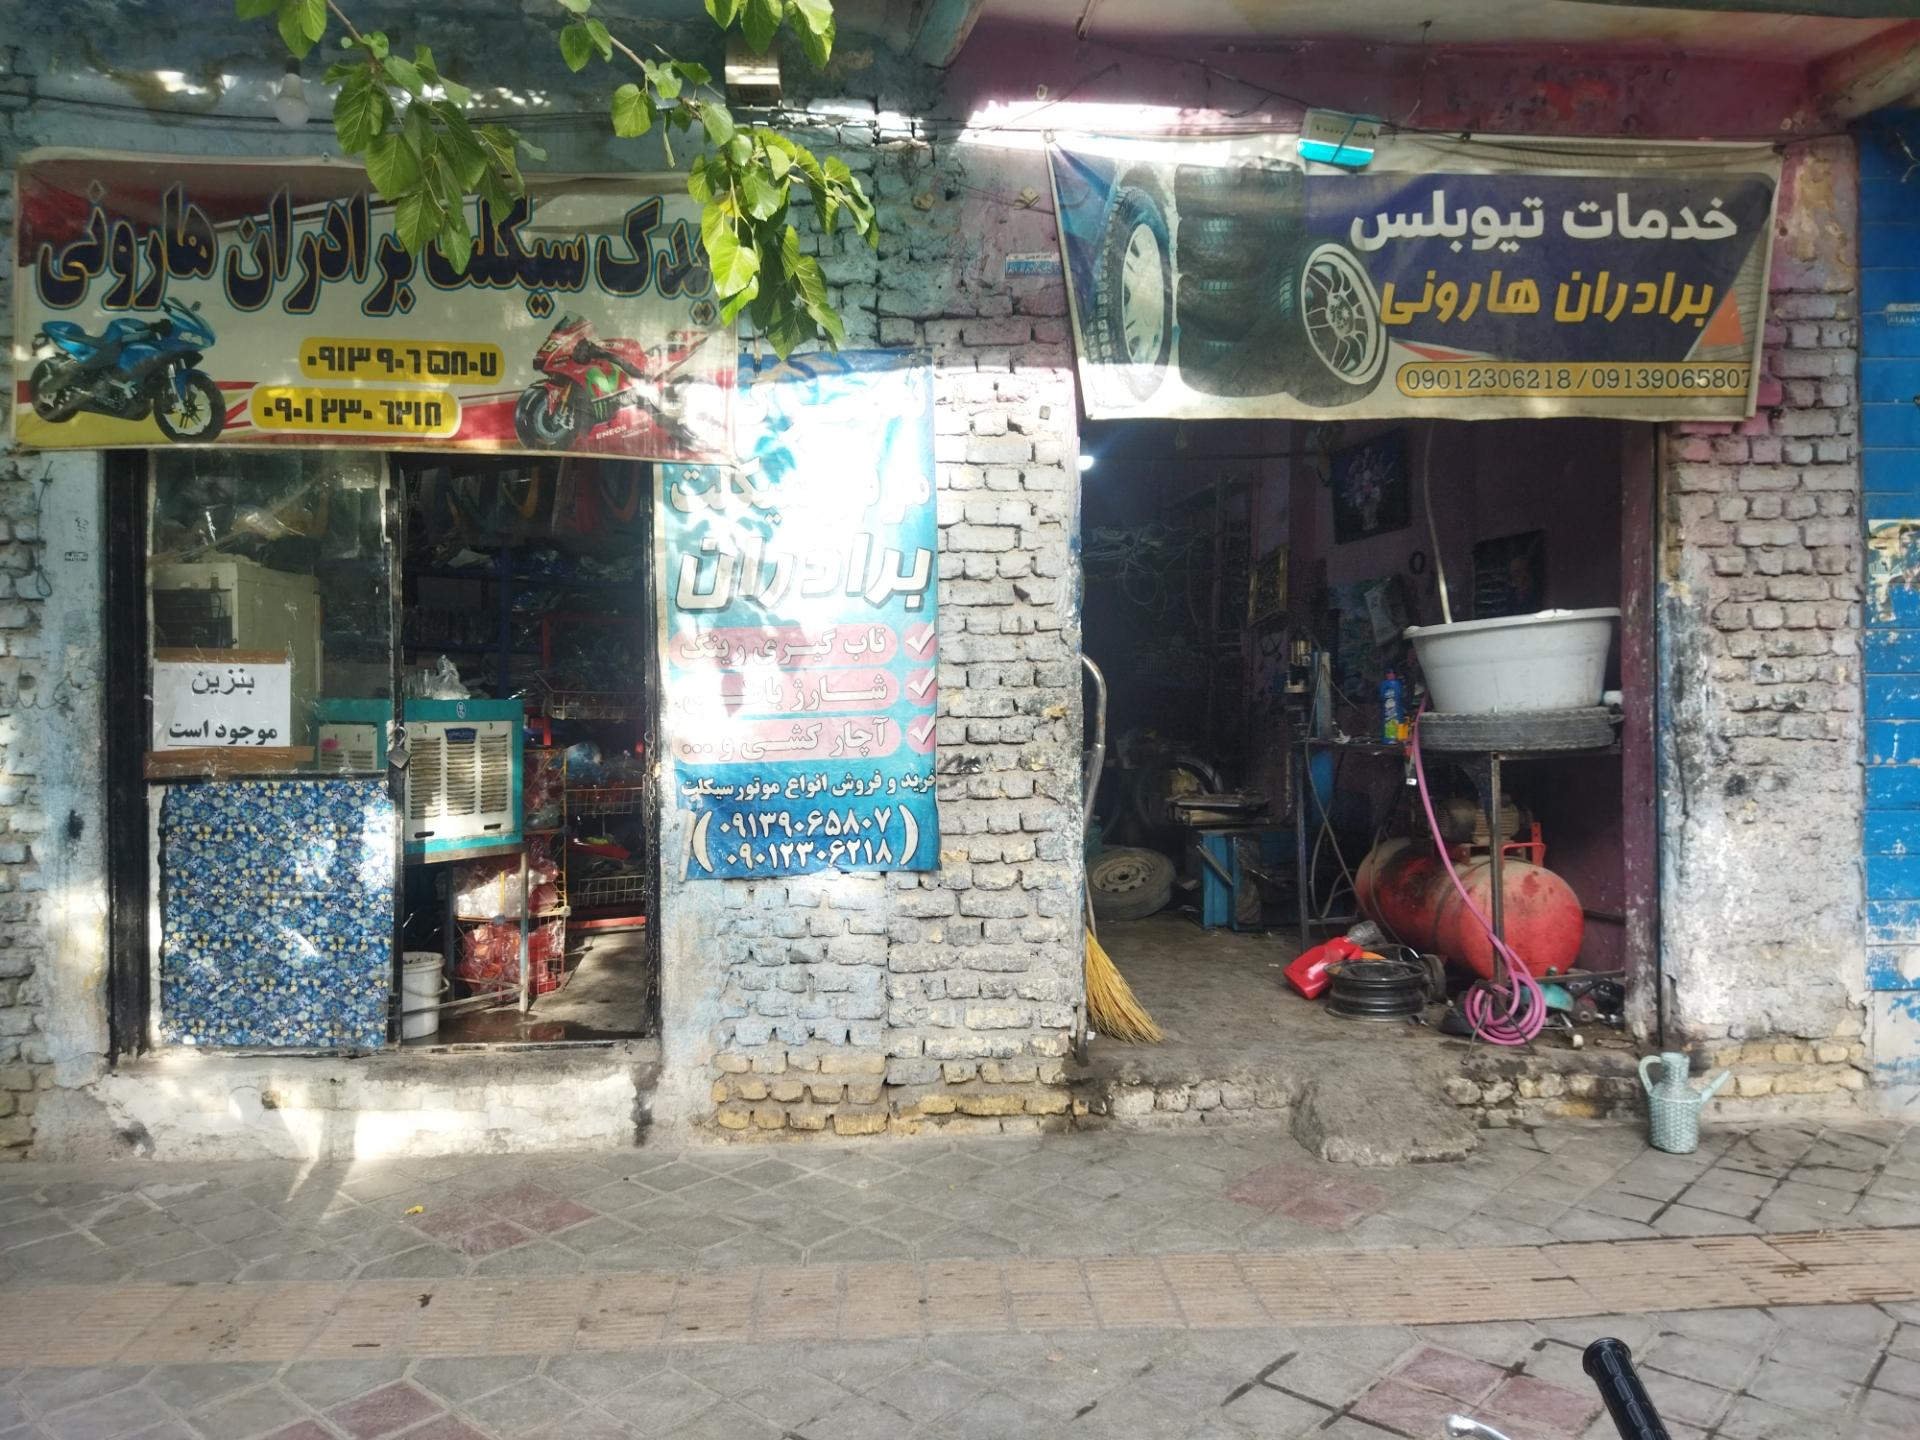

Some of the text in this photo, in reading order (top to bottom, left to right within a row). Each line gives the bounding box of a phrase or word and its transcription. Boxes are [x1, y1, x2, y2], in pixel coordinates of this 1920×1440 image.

[1350, 190, 1738, 254] خدمات تیوبلس
[35, 180, 219, 311] هارونی
[224, 182, 417, 317] برادران
[1379, 269, 1714, 327] برادران هارونی
[675, 532, 933, 612] برادران
[753, 628, 837, 666] گیری
[843, 626, 886, 661] تاب
[191, 667, 255, 695] بنزین
[790, 674, 889, 711] شارژ
[169, 719, 278, 746] موجود است
[719, 736, 735, 762] و
[741, 722, 823, 761] کشی
[829, 716, 889, 758] آچار
[784, 773, 828, 800] انواع
[831, 769, 882, 796] فروش
[886, 776, 898, 795] و
[900, 768, 936, 794] خرید
